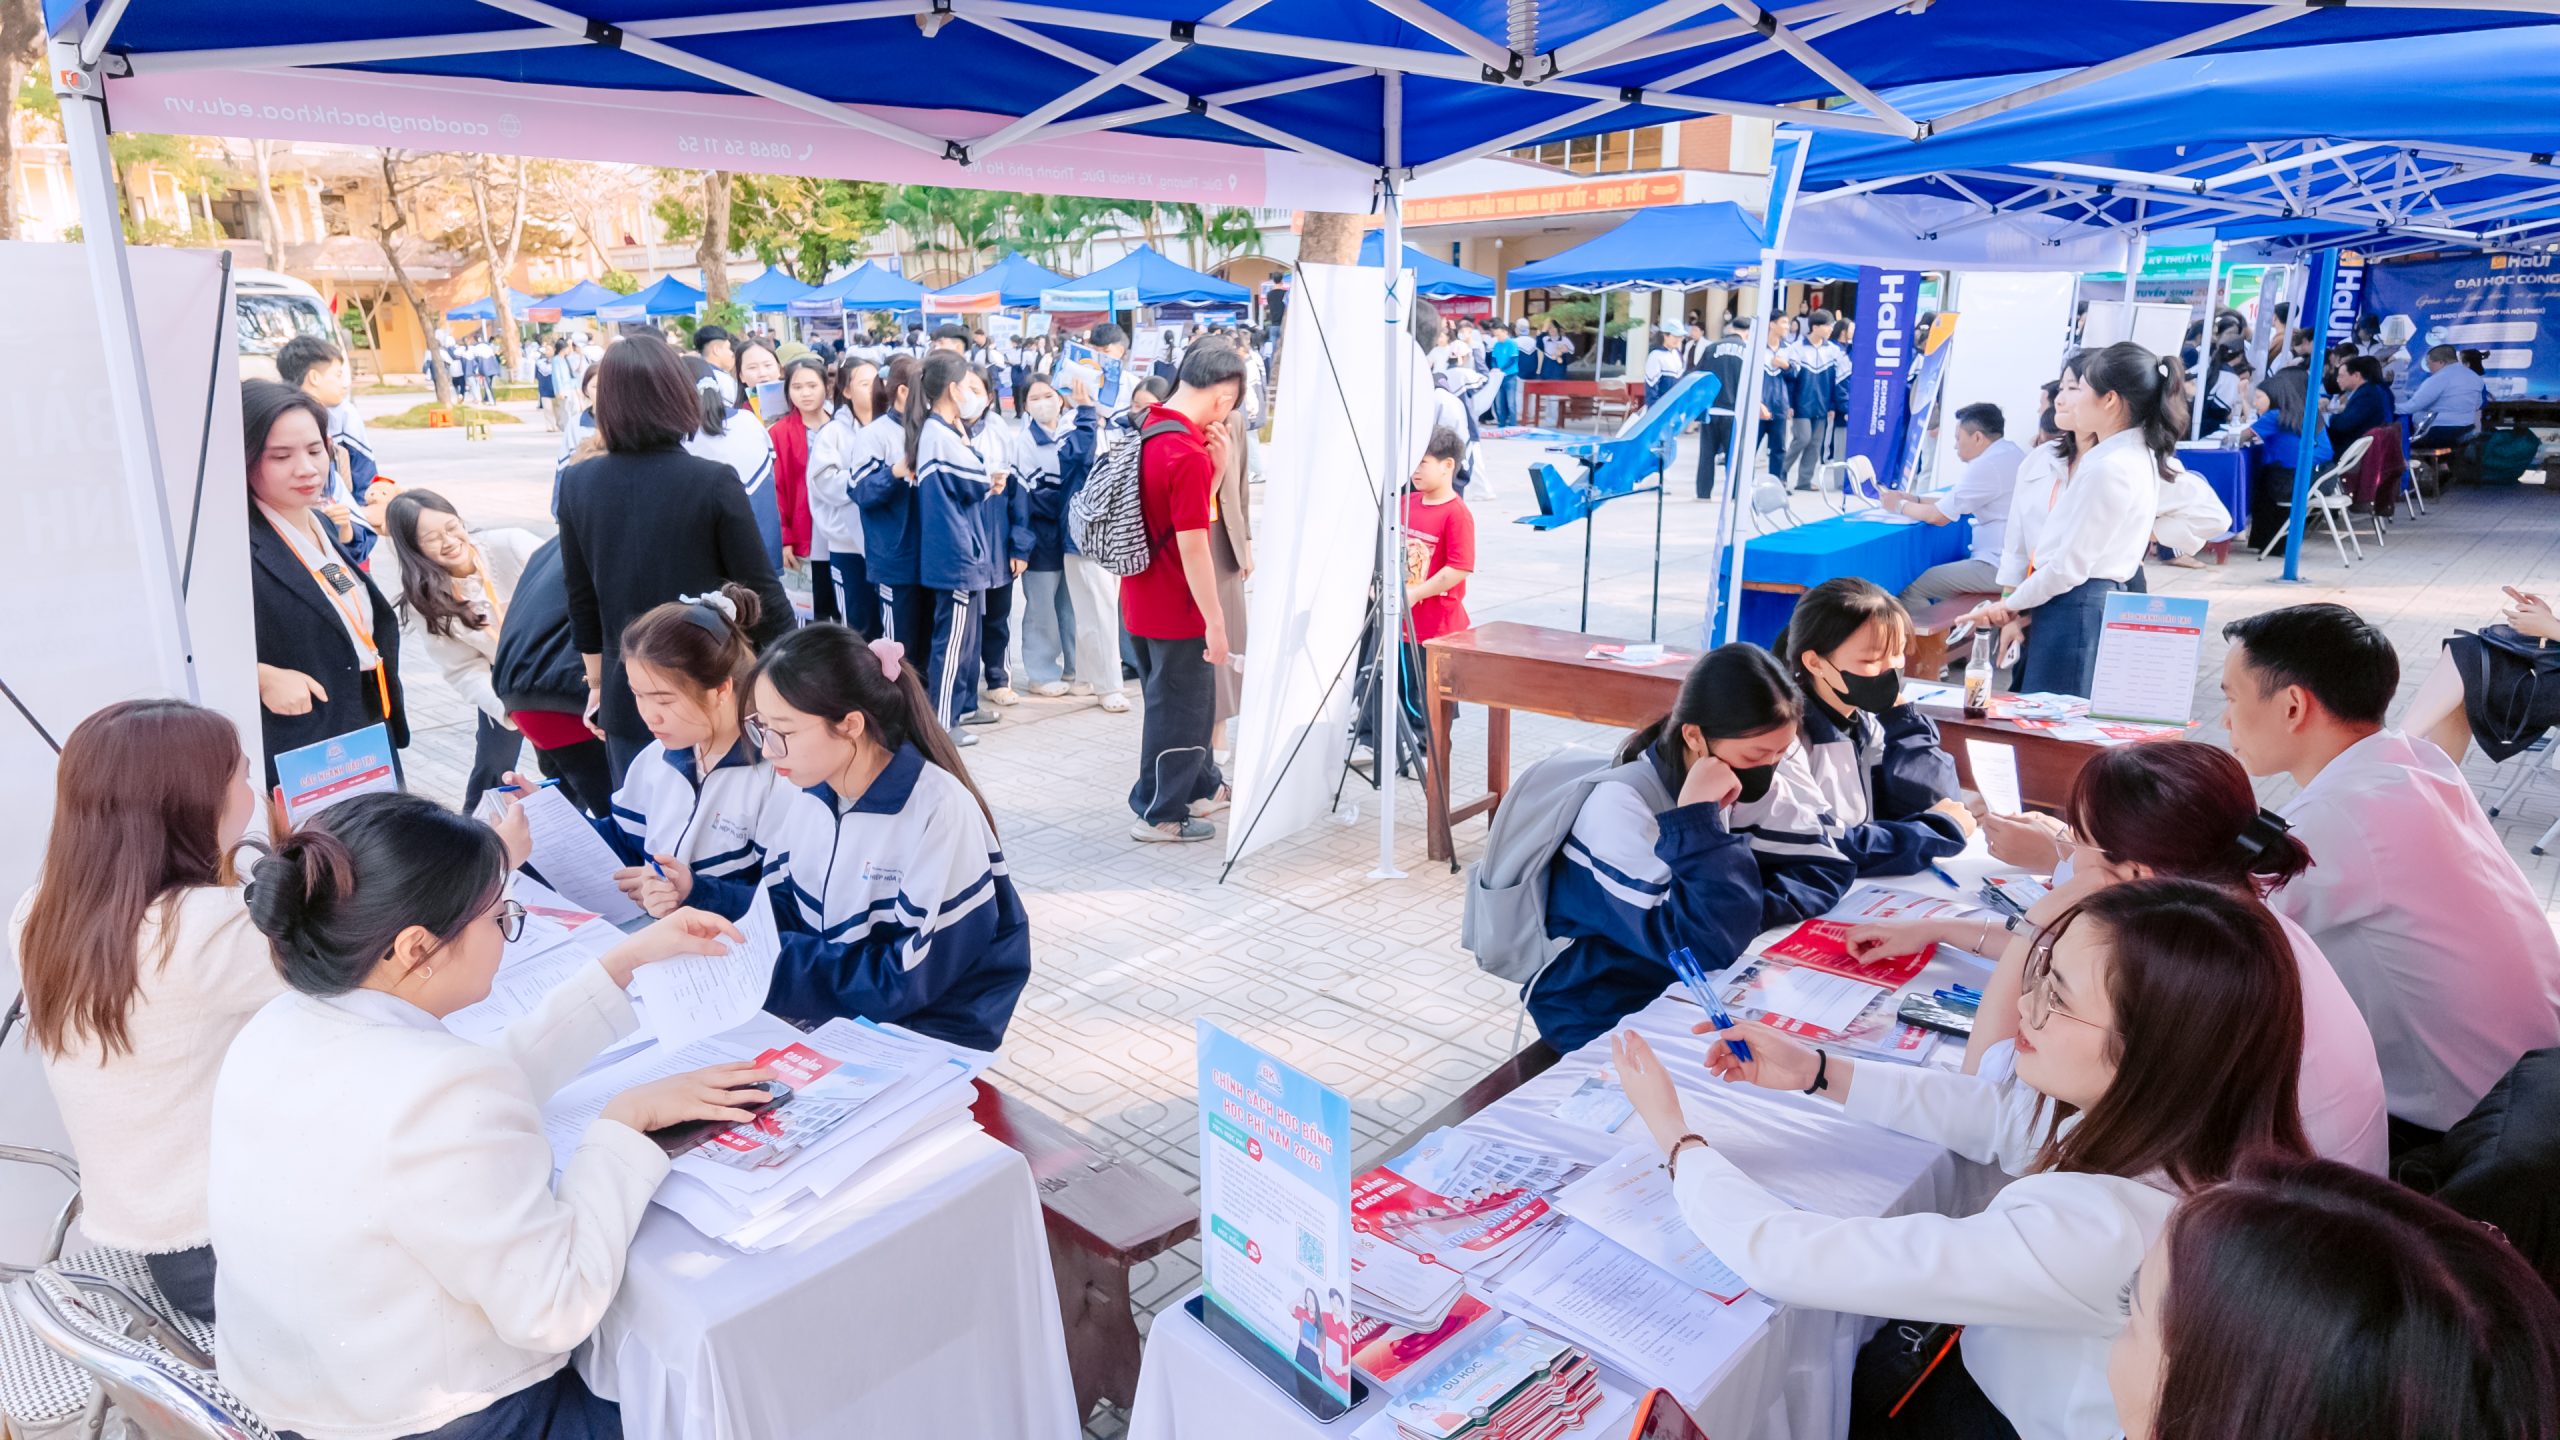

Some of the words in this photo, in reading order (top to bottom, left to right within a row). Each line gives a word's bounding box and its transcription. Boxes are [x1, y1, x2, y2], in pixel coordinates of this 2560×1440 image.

[1565, 185, 1588, 207] TỐT
[1597, 187, 1622, 207] HỌC
[1625, 179, 1648, 202] TỐT
[2454, 278, 2480, 291] ĐẠI
[2484, 275, 2514, 287] HỌC
[2517, 271, 2560, 285] CÔNG
[2508, 254, 2552, 268] HaUI
[1875, 275, 1904, 368] HaUI
[2326, 269, 2362, 337] HaUI
[1869, 379, 1881, 436] ECONOMICS
[1878, 379, 1889, 419] SCHOOL
[1878, 420, 1887, 433] OF
[1213, 1069, 1243, 1098] CHÍNH
[1247, 1088, 1273, 1117] SÁCH
[1277, 1107, 1299, 1133] HỌC
[1302, 1121, 1332, 1154] BỔNG
[1224, 1098, 1244, 1121] HỌC
[1247, 1113, 1265, 1136] PHÍ
[1268, 1126, 1291, 1151] NĂM
[1294, 1142, 1321, 1170] 2026
[1355, 1194, 1383, 1210] BÁCH
[1379, 1182, 1407, 1196] KHOA
[1484, 1206, 1516, 1228] SINH
[1513, 1188, 1543, 1210] 2026
[1442, 1378, 1460, 1392] DU
